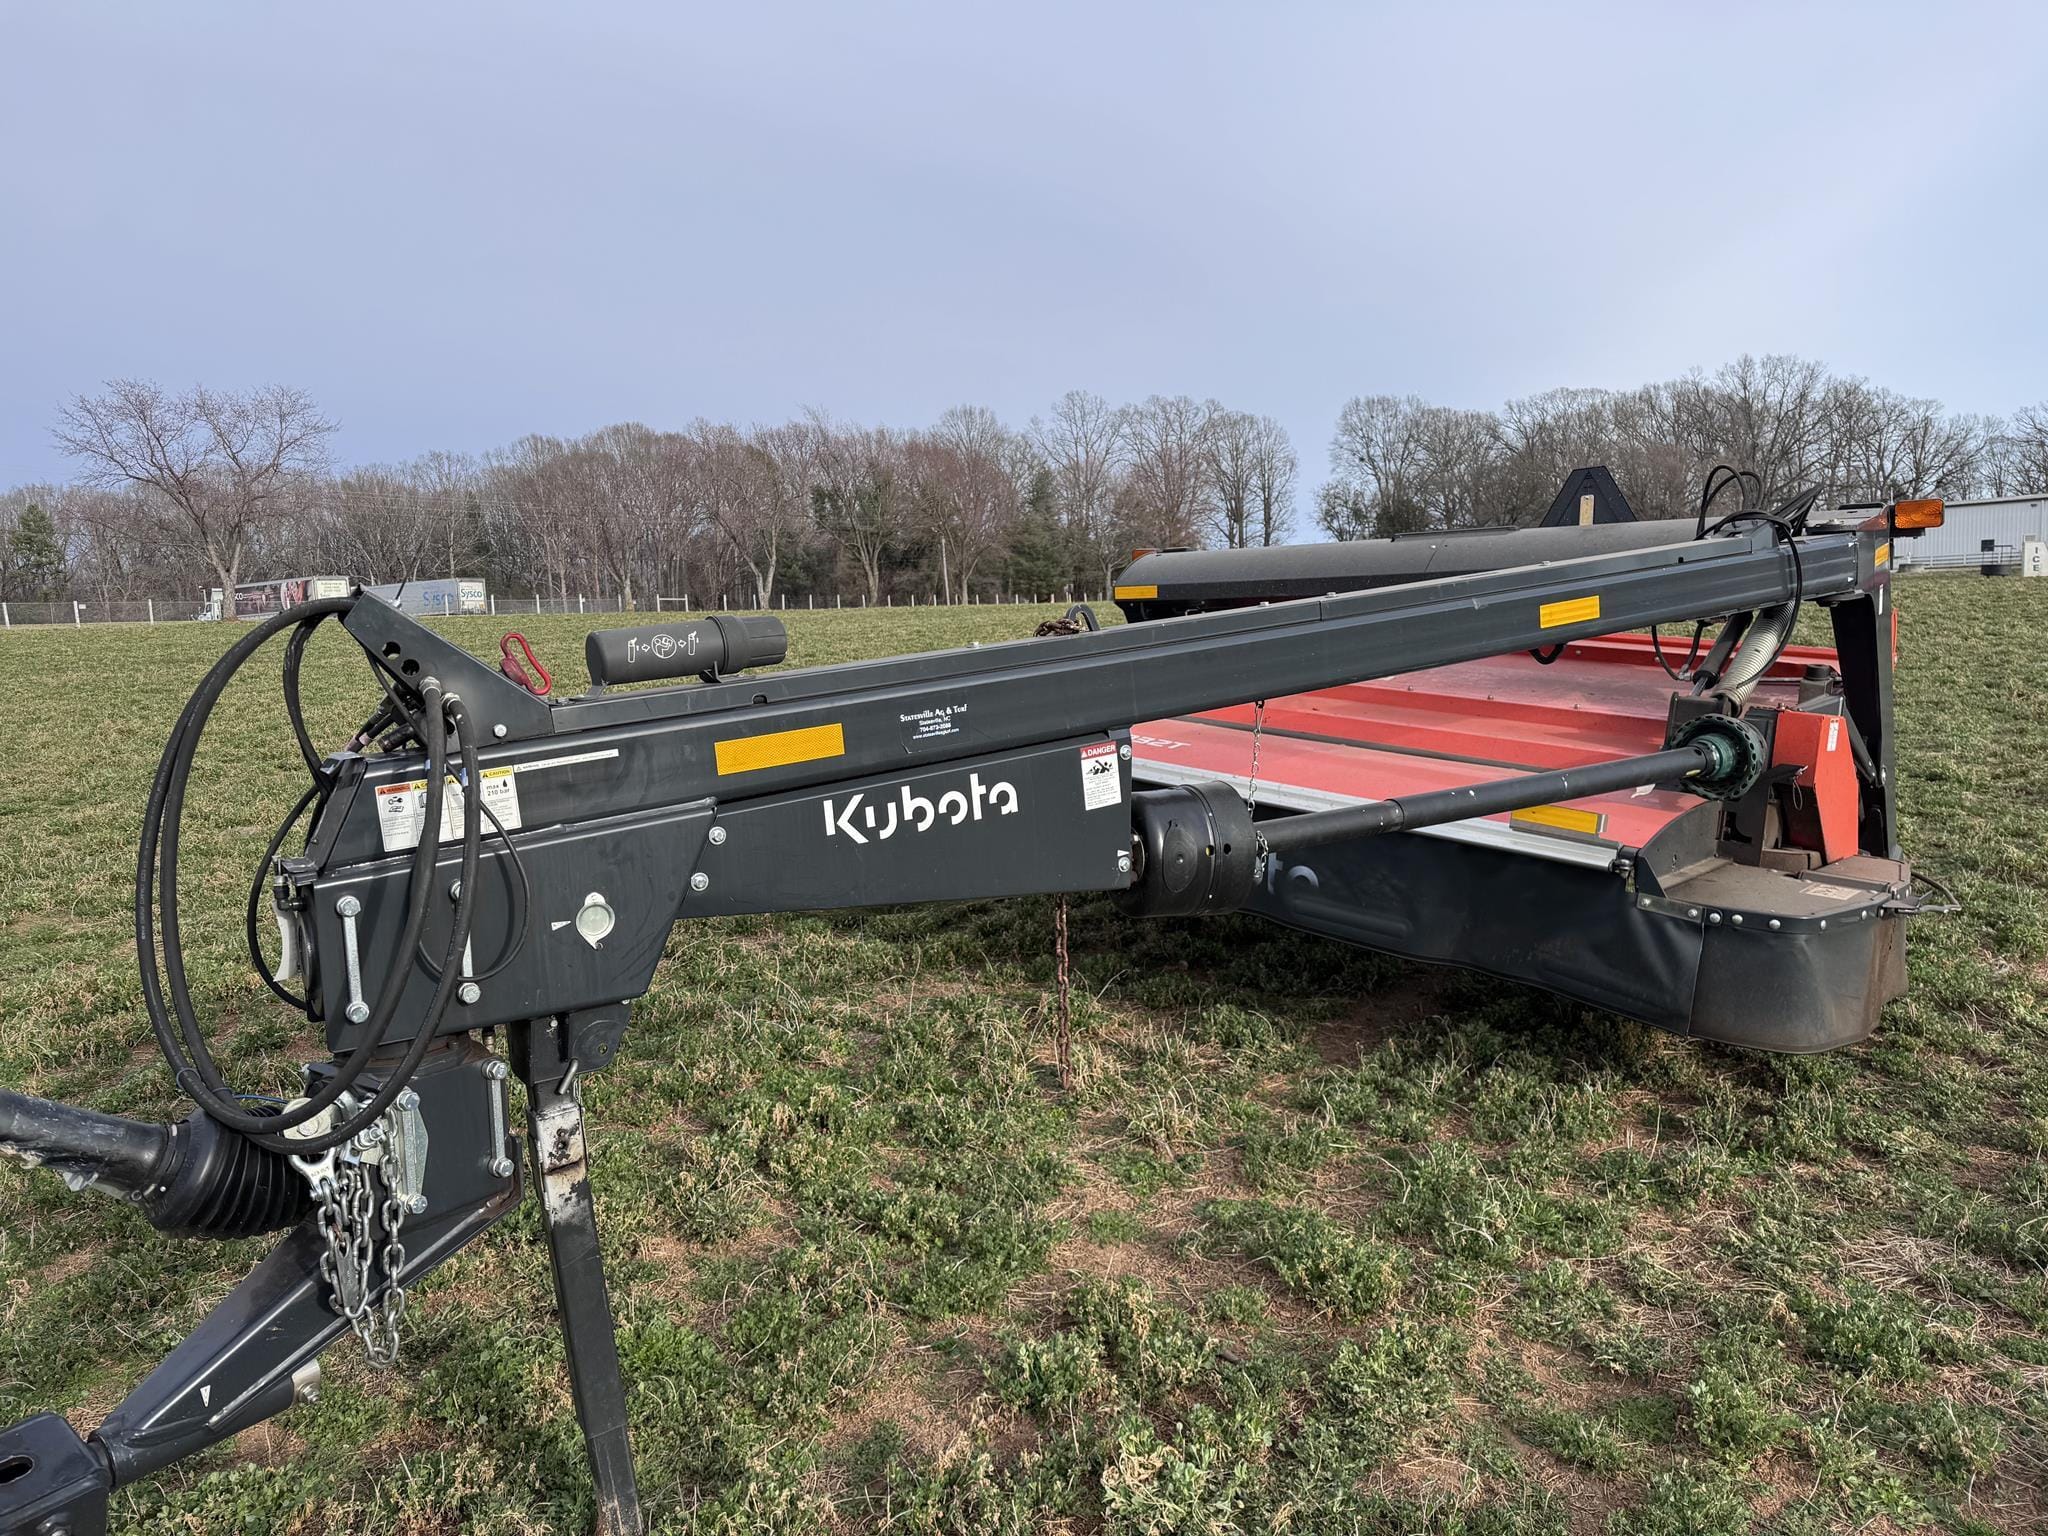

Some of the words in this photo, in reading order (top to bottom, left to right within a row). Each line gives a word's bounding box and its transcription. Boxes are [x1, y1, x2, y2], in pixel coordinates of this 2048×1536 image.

[460, 588, 483, 599] Sysco
[1087, 744, 1116, 757] DANGER
[488, 769, 510, 777] CAUTION
[487, 789, 499, 797] 210
[823, 773, 1019, 844] Kubota
